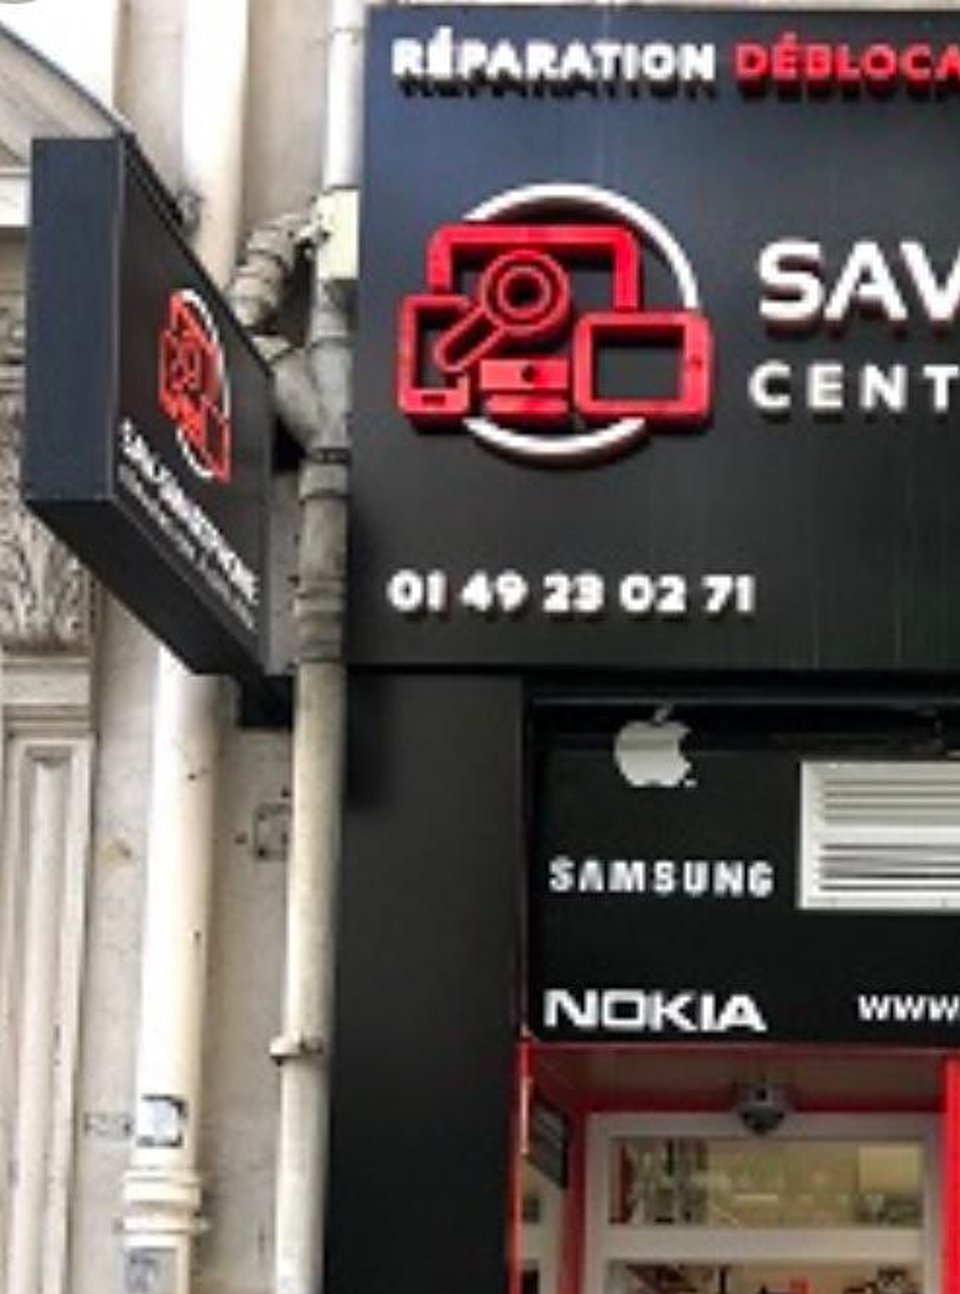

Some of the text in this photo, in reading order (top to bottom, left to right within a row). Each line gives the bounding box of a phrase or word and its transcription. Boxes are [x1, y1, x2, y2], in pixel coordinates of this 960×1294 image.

[391, 27, 716, 81] RÉPARATION
[387, 570, 756, 613] 01 49 23 02 71
[549, 857, 773, 897] SAMSUNG
[544, 990, 767, 1031] NOKIA
